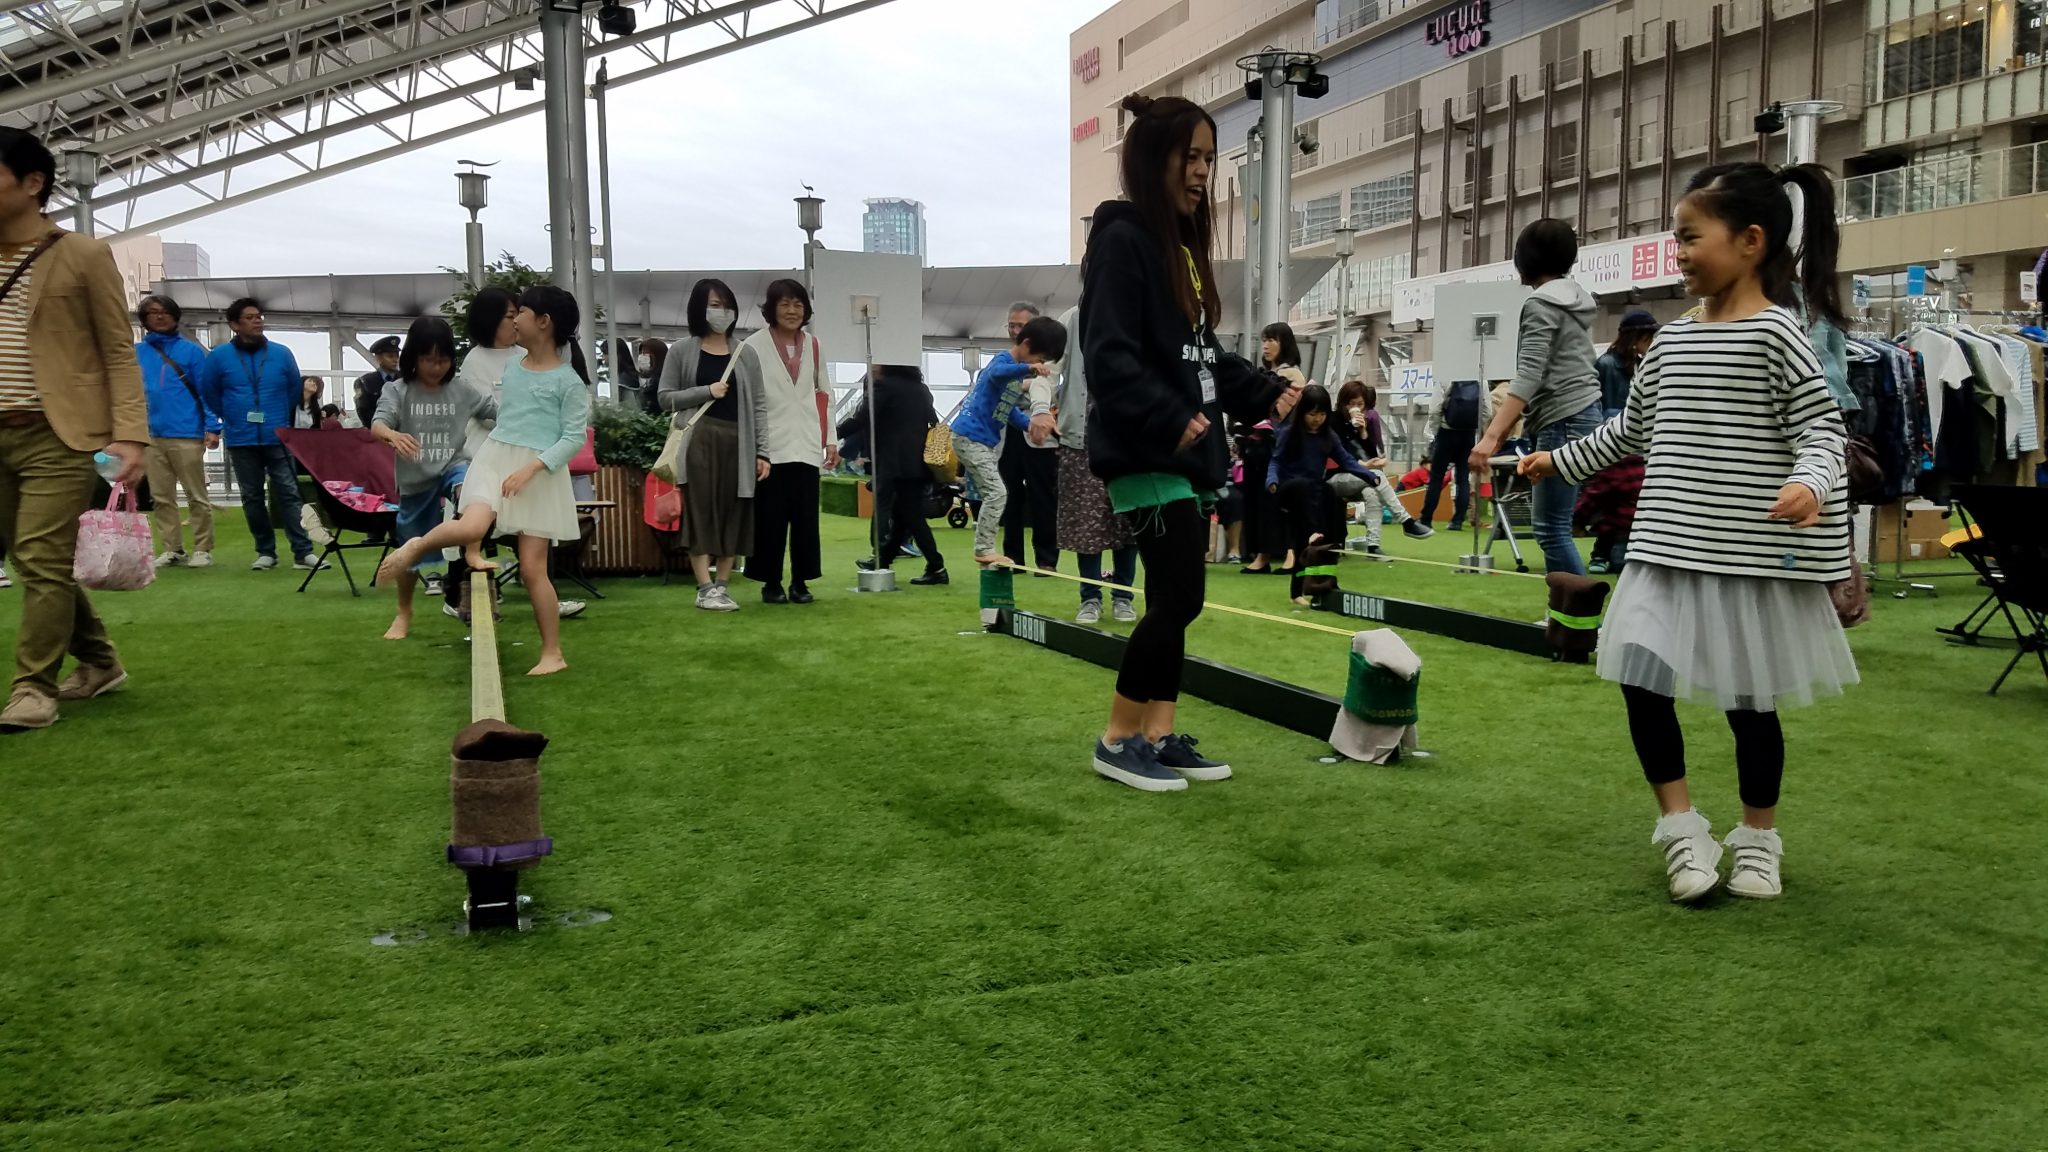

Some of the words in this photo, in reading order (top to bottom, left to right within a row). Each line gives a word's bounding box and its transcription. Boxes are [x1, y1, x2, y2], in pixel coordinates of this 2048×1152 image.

[418, 432, 450, 445] TIME
[1343, 593, 1384, 620] GIBBON
[1013, 613, 1047, 644] GIBBON
